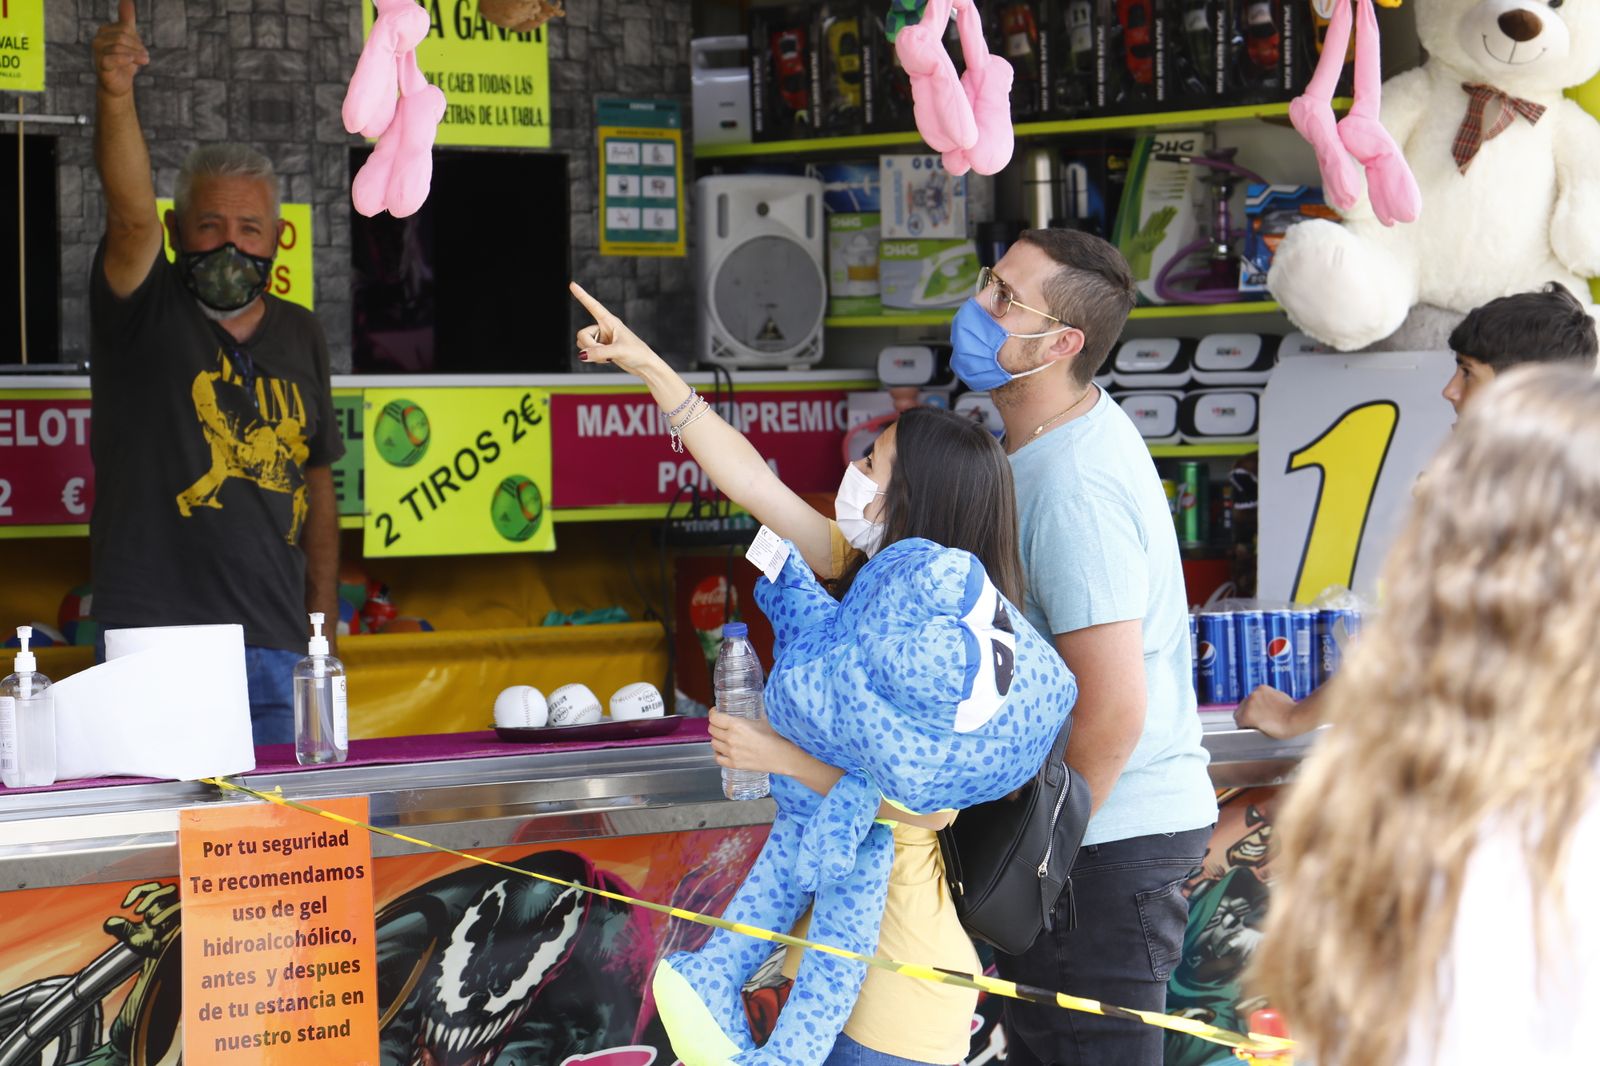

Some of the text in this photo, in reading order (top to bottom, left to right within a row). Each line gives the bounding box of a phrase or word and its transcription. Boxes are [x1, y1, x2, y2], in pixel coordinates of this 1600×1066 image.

[0, 55, 20, 69] DO
[448, 72, 474, 93] CAER
[478, 73, 511, 95] TODAS
[514, 75, 533, 95] LAS
[442, 104, 544, 127] ETRAS DE LA TABLA
[375, 513, 401, 547] 2
[399, 430, 501, 522] TIROS
[1285, 398, 1400, 609] 1
[203, 830, 349, 857] Por tu seguridad
[190, 865, 364, 894] Te recomendamos
[233, 896, 327, 921] uso de gel
[203, 927, 357, 957] hidroalcohólico,
[201, 959, 361, 989] antes y despues
[199, 990, 364, 1021] de tu estancia en
[215, 1019, 351, 1052] nuestro stand
